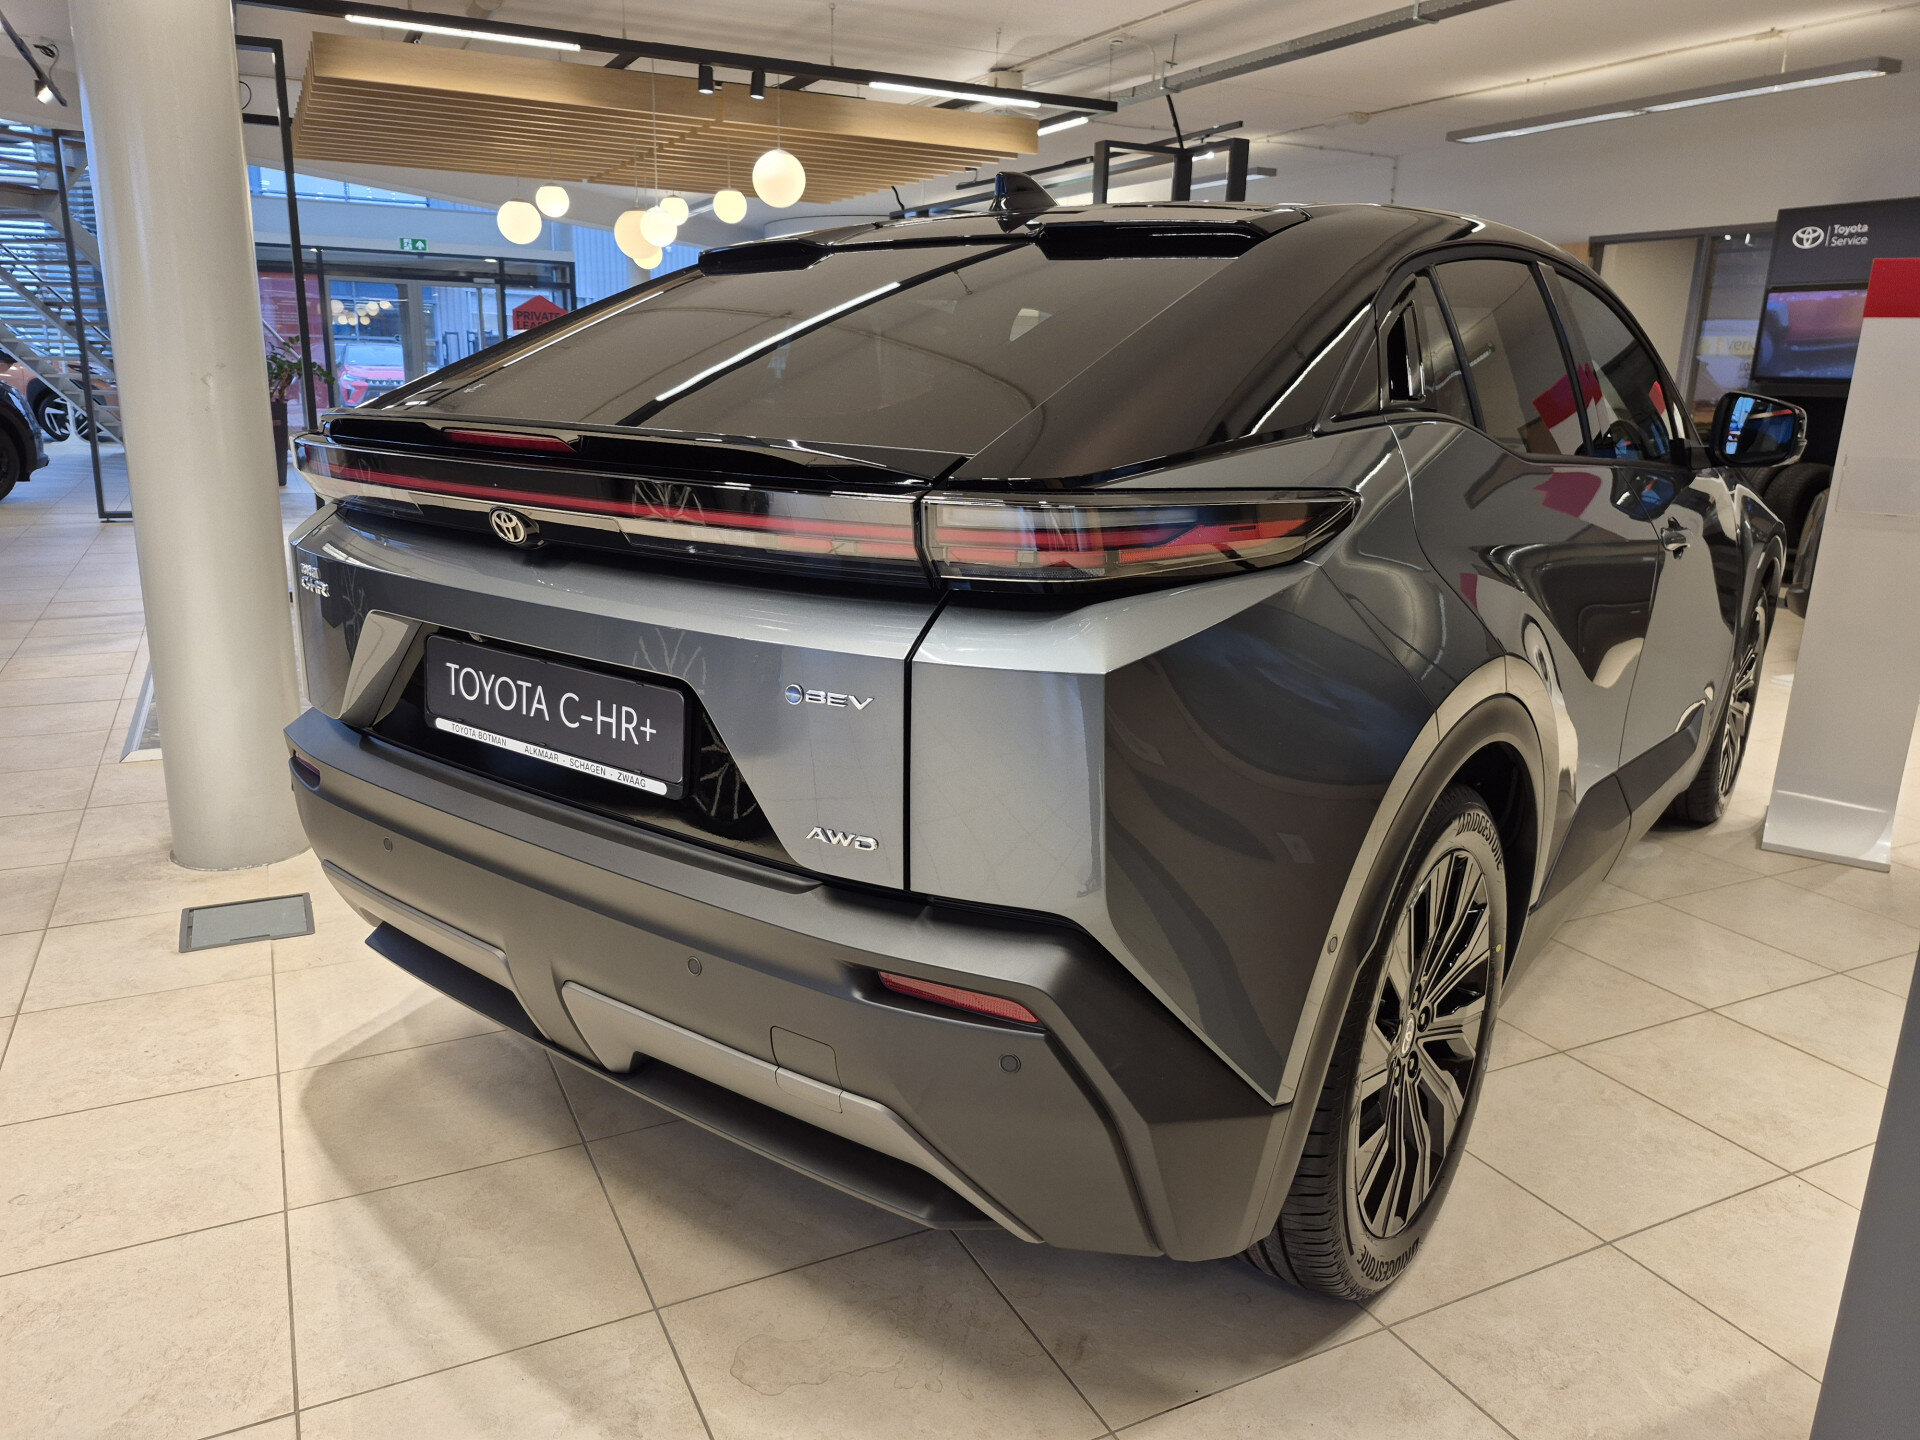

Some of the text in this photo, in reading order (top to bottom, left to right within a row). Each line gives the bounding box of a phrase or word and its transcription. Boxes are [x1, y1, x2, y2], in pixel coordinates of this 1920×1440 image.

[1830, 235, 1869, 247] Service
[1833, 223, 1869, 236] Toyota
[446, 662, 657, 745] TOYOTA C-HR+
[805, 689, 875, 711] BEV
[452, 723, 476, 737] TOYOTA
[478, 731, 507, 747] BOTMAN
[524, 745, 559, 762] ALKMAAR
[569, 757, 606, 776] SCHAGEN
[617, 771, 646, 788] ZWAAG
[806, 826, 879, 851] AWD
